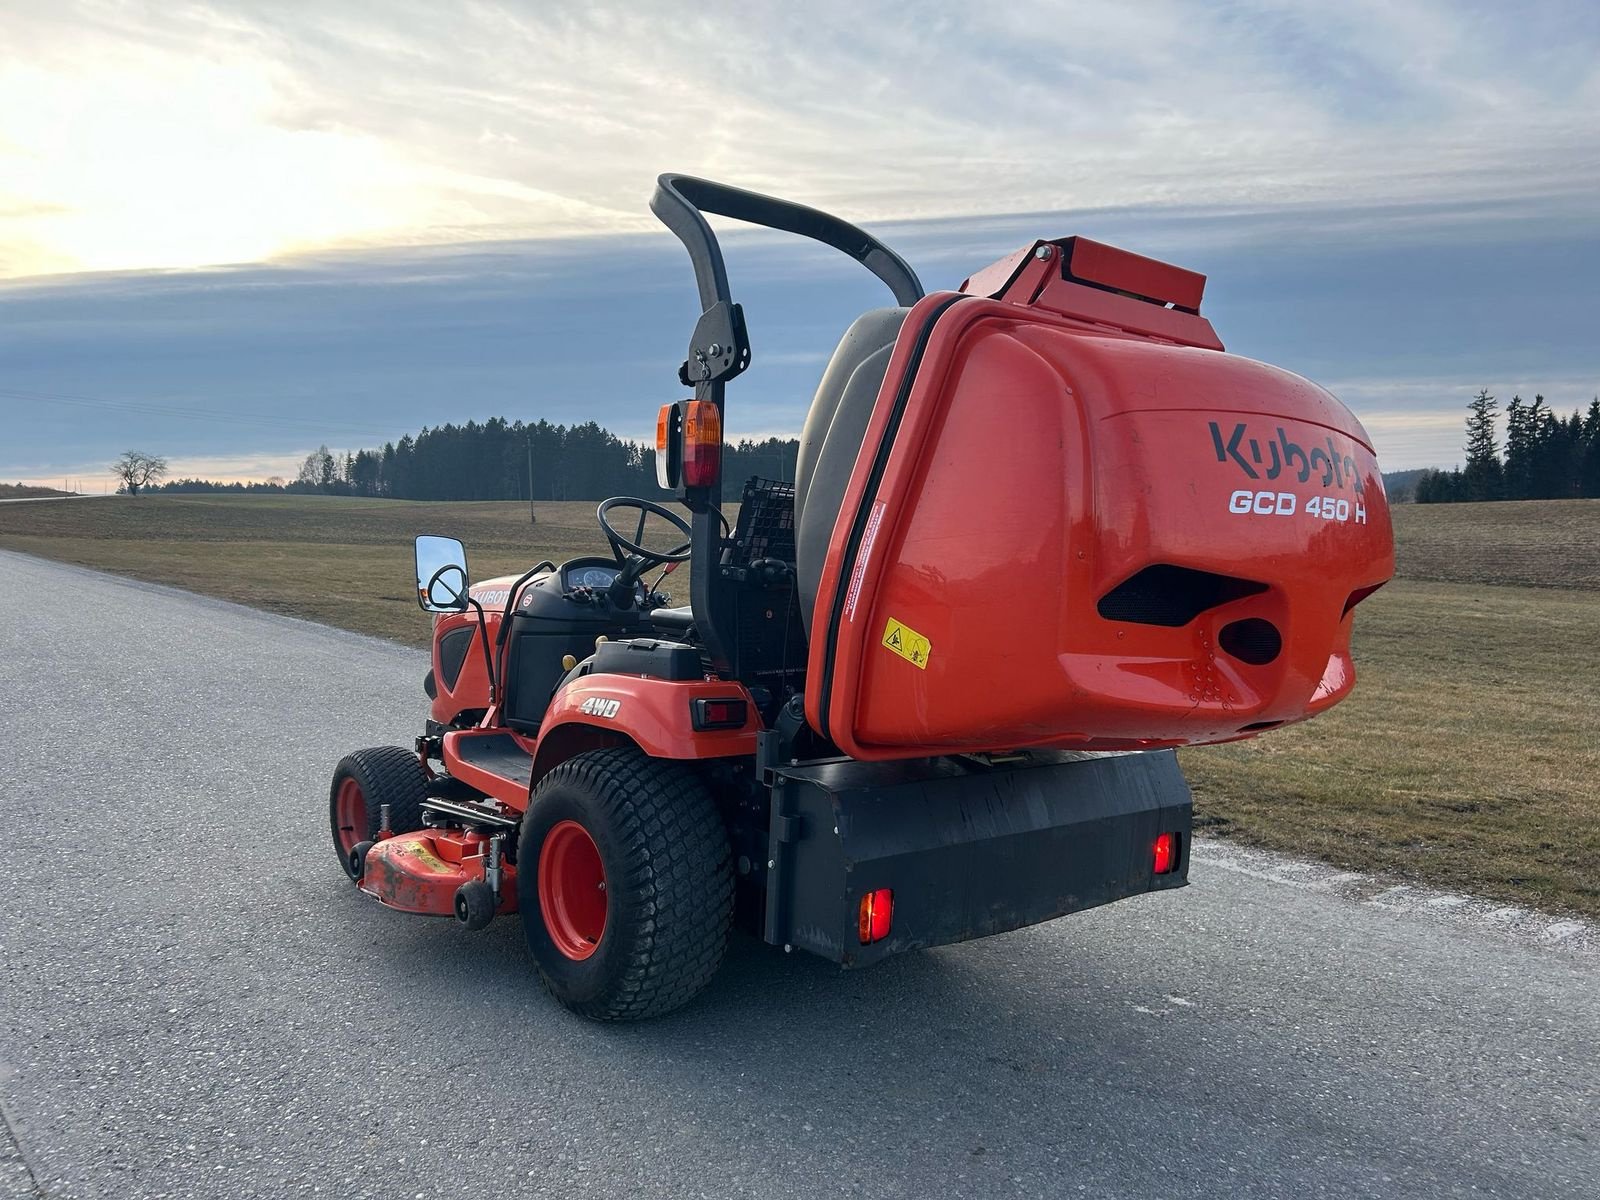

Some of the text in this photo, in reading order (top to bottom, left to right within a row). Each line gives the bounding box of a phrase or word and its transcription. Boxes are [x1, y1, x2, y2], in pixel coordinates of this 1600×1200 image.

[1208, 421, 1363, 496] Kubota
[1229, 490, 1367, 525] GCD 450 H
[474, 590, 510, 605] KUBOT
[581, 697, 621, 719] 4WD
